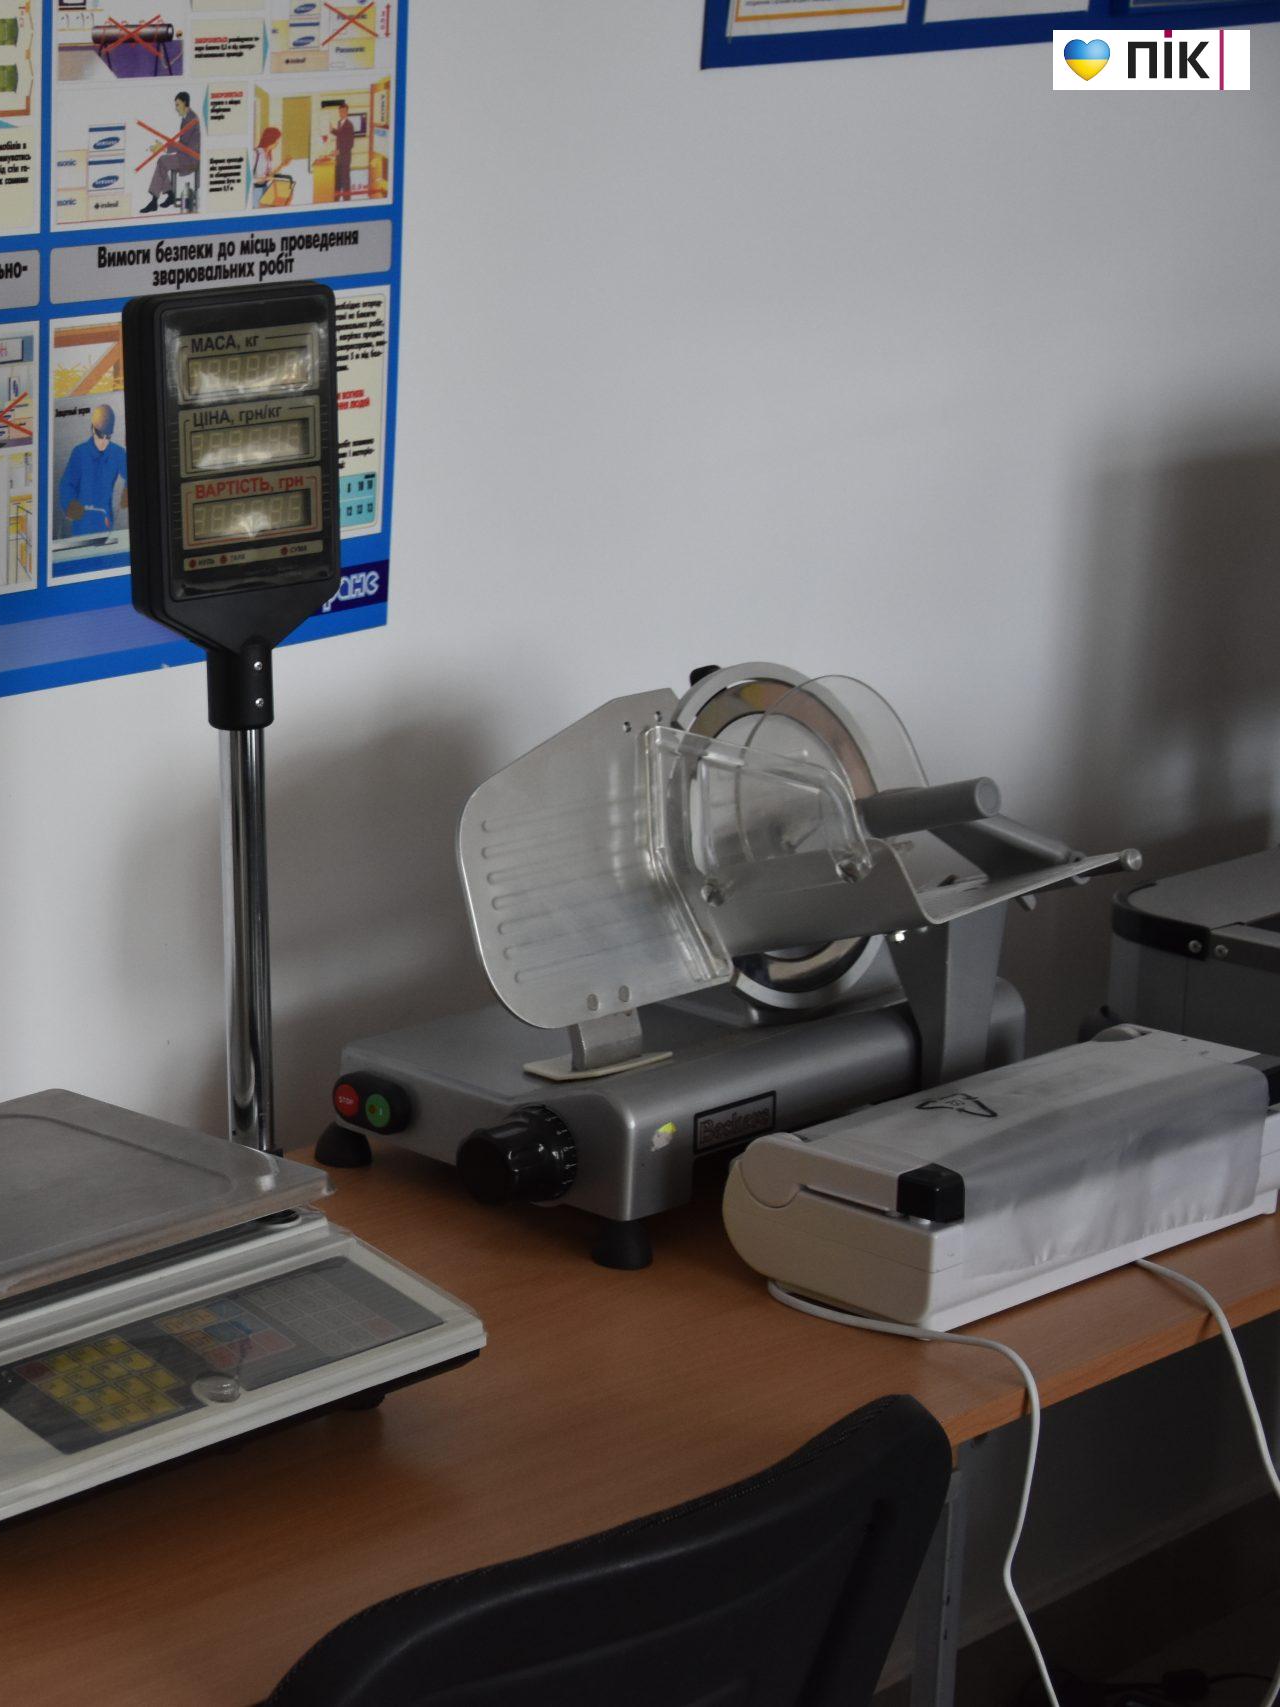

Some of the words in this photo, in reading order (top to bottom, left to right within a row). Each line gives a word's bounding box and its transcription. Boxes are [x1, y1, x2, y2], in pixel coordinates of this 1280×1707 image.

[97, 245, 150, 269] Вимоги
[155, 240, 214, 264] безпеки
[217, 238, 236, 258] до
[240, 232, 276, 255] місць
[280, 228, 359, 252] проведення
[152, 263, 254, 290] зварювальних
[259, 255, 295, 283] робіт
[191, 334, 240, 353] МАСА,
[192, 409, 234, 428] ЦІНА,
[194, 477, 274, 499] ВАРТІСТЬ,
